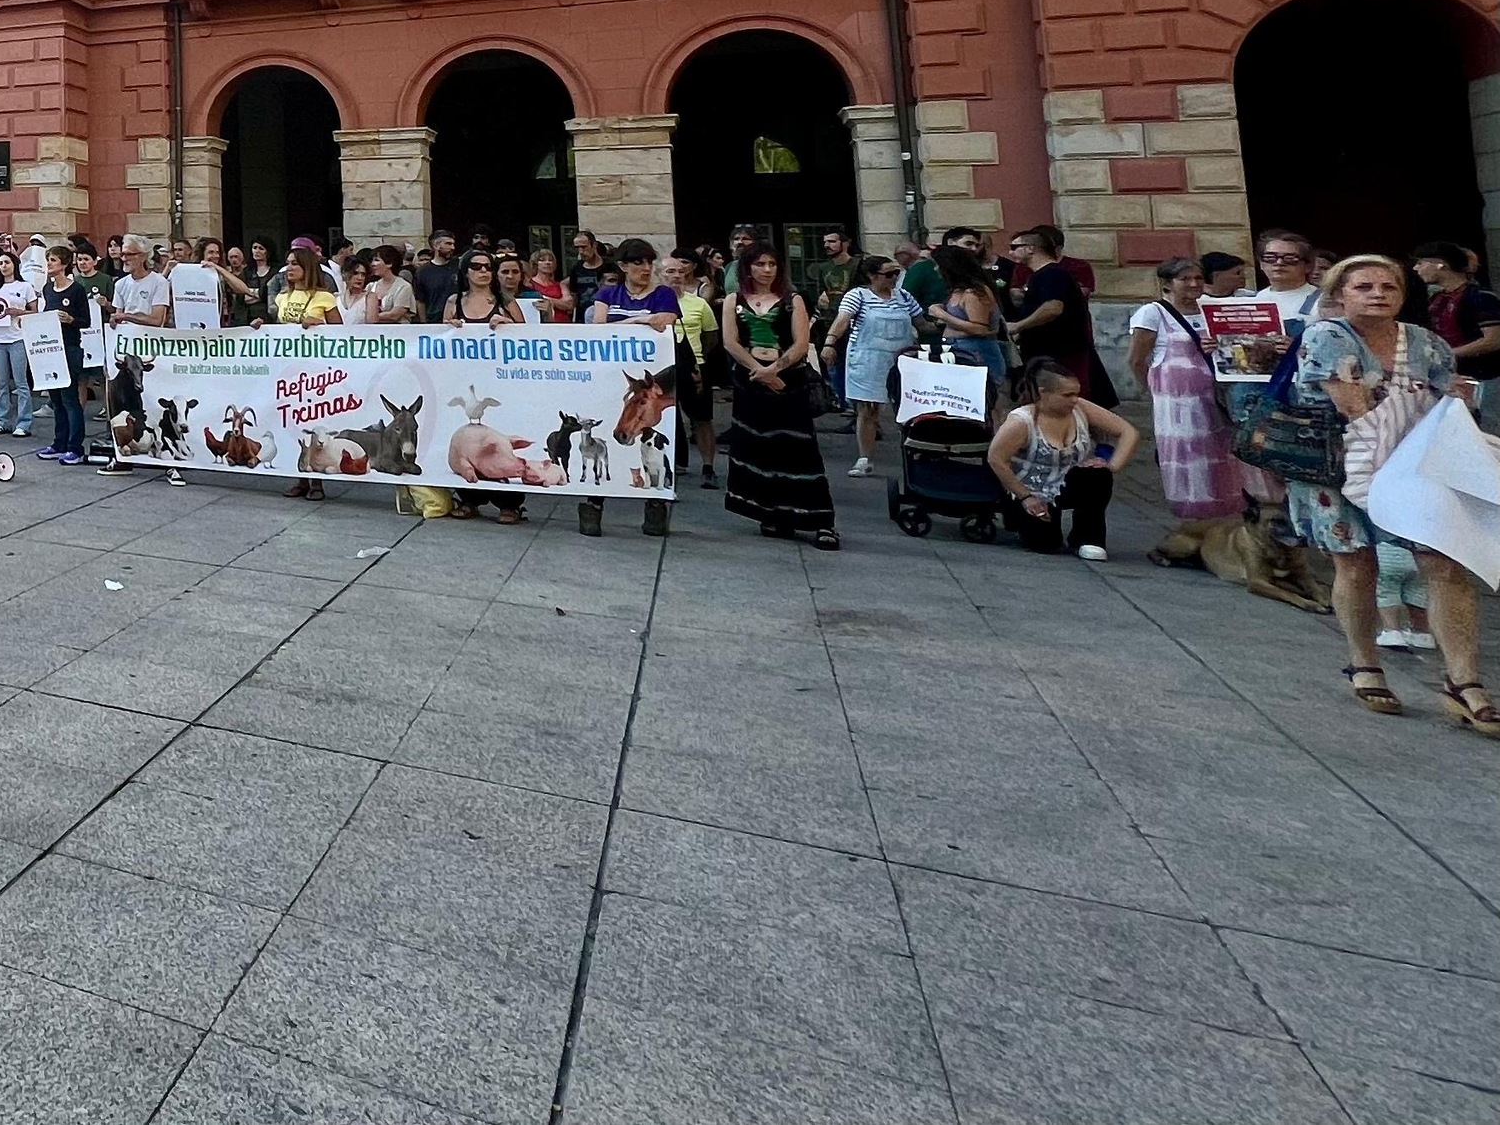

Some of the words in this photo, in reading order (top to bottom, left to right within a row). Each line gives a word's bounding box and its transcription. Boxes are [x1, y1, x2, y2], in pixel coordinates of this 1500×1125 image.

[117, 333, 129, 355] Ez
[201, 334, 235, 361] jaio
[239, 333, 269, 358] zuri
[273, 334, 406, 359] zerbitzatzeko
[418, 334, 446, 360] No
[451, 332, 497, 361] nací
[502, 337, 552, 365] para
[558, 334, 656, 363] servirte
[276, 366, 348, 403] Refugio
[496, 367, 509, 380] Su
[509, 366, 529, 380] vida
[531, 369, 543, 380] es
[567, 370, 592, 382] suya
[276, 393, 363, 429] Tximas
